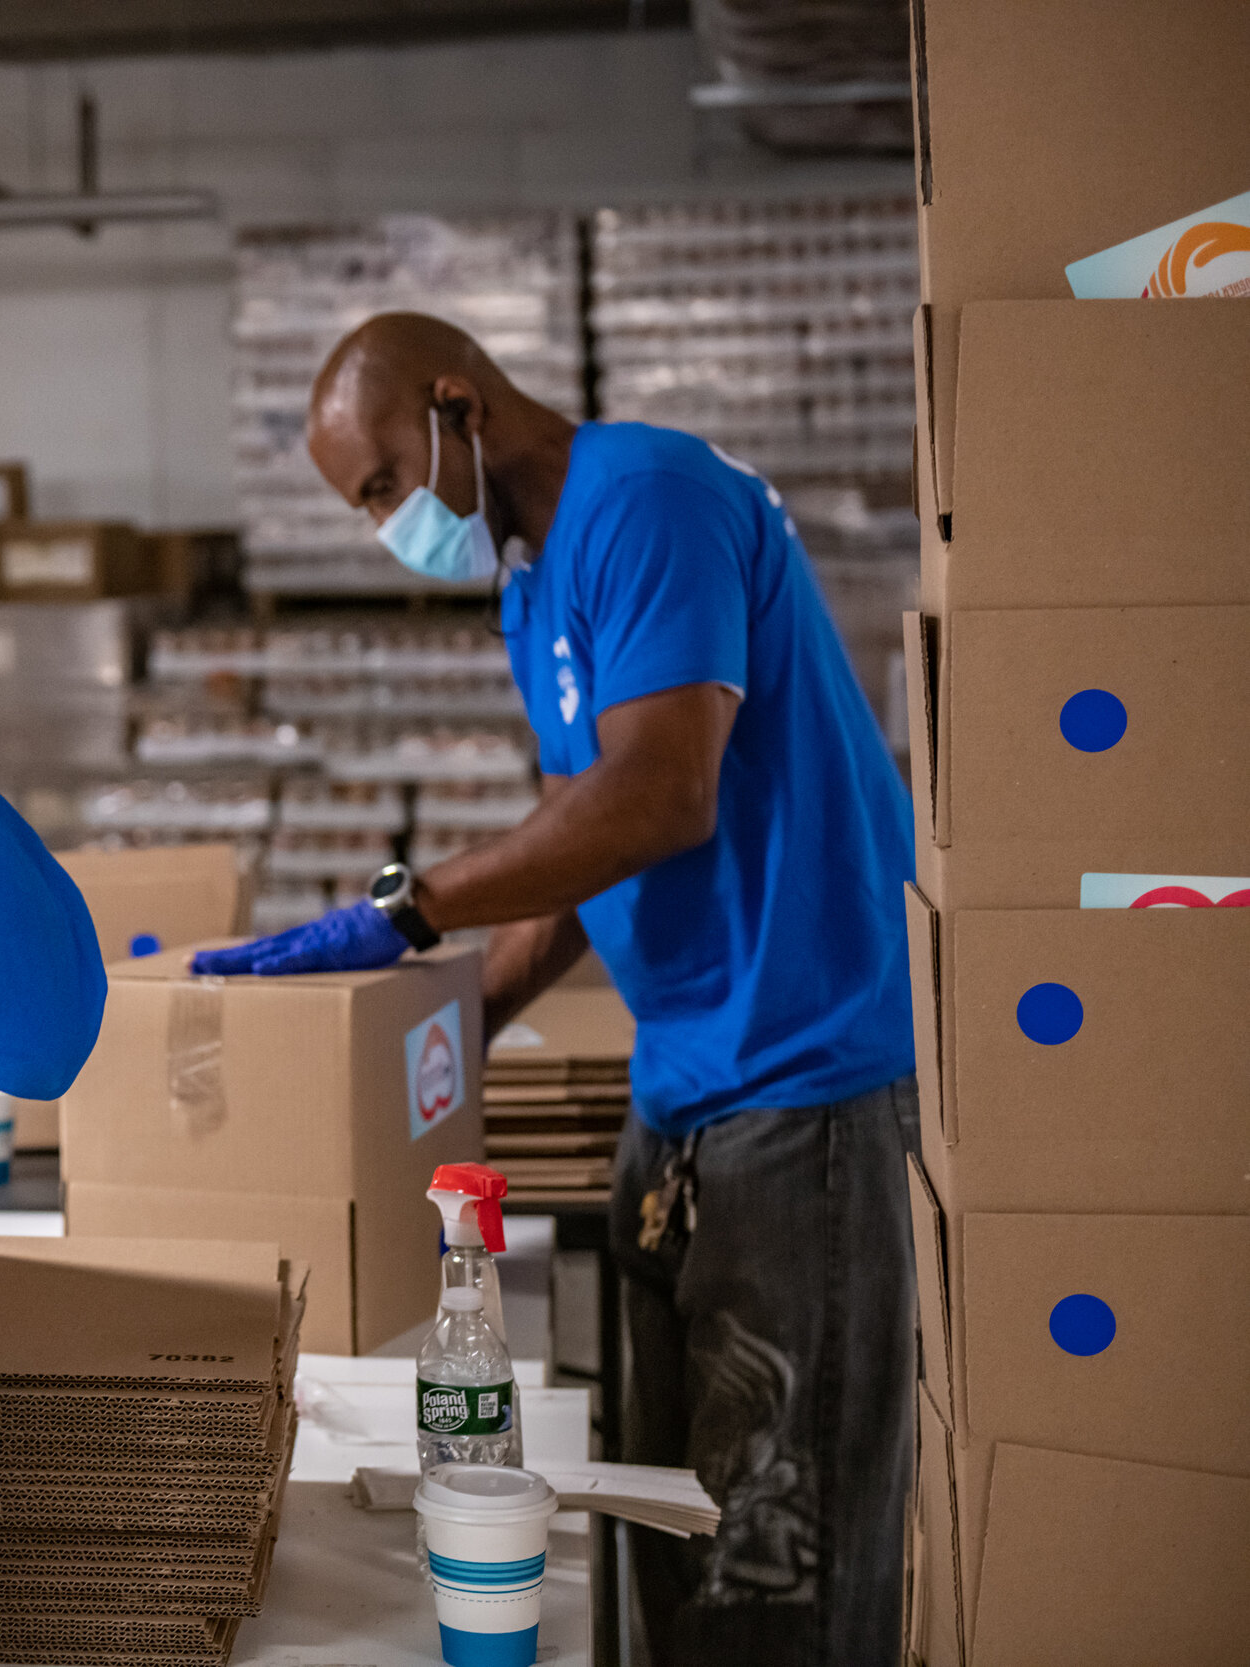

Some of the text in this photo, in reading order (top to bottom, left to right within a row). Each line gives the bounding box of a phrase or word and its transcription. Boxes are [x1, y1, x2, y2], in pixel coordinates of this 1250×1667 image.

[148, 1353, 235, 1364] 70382
[422, 1390, 467, 1407] Poland
[422, 1405, 469, 1424] Spring
